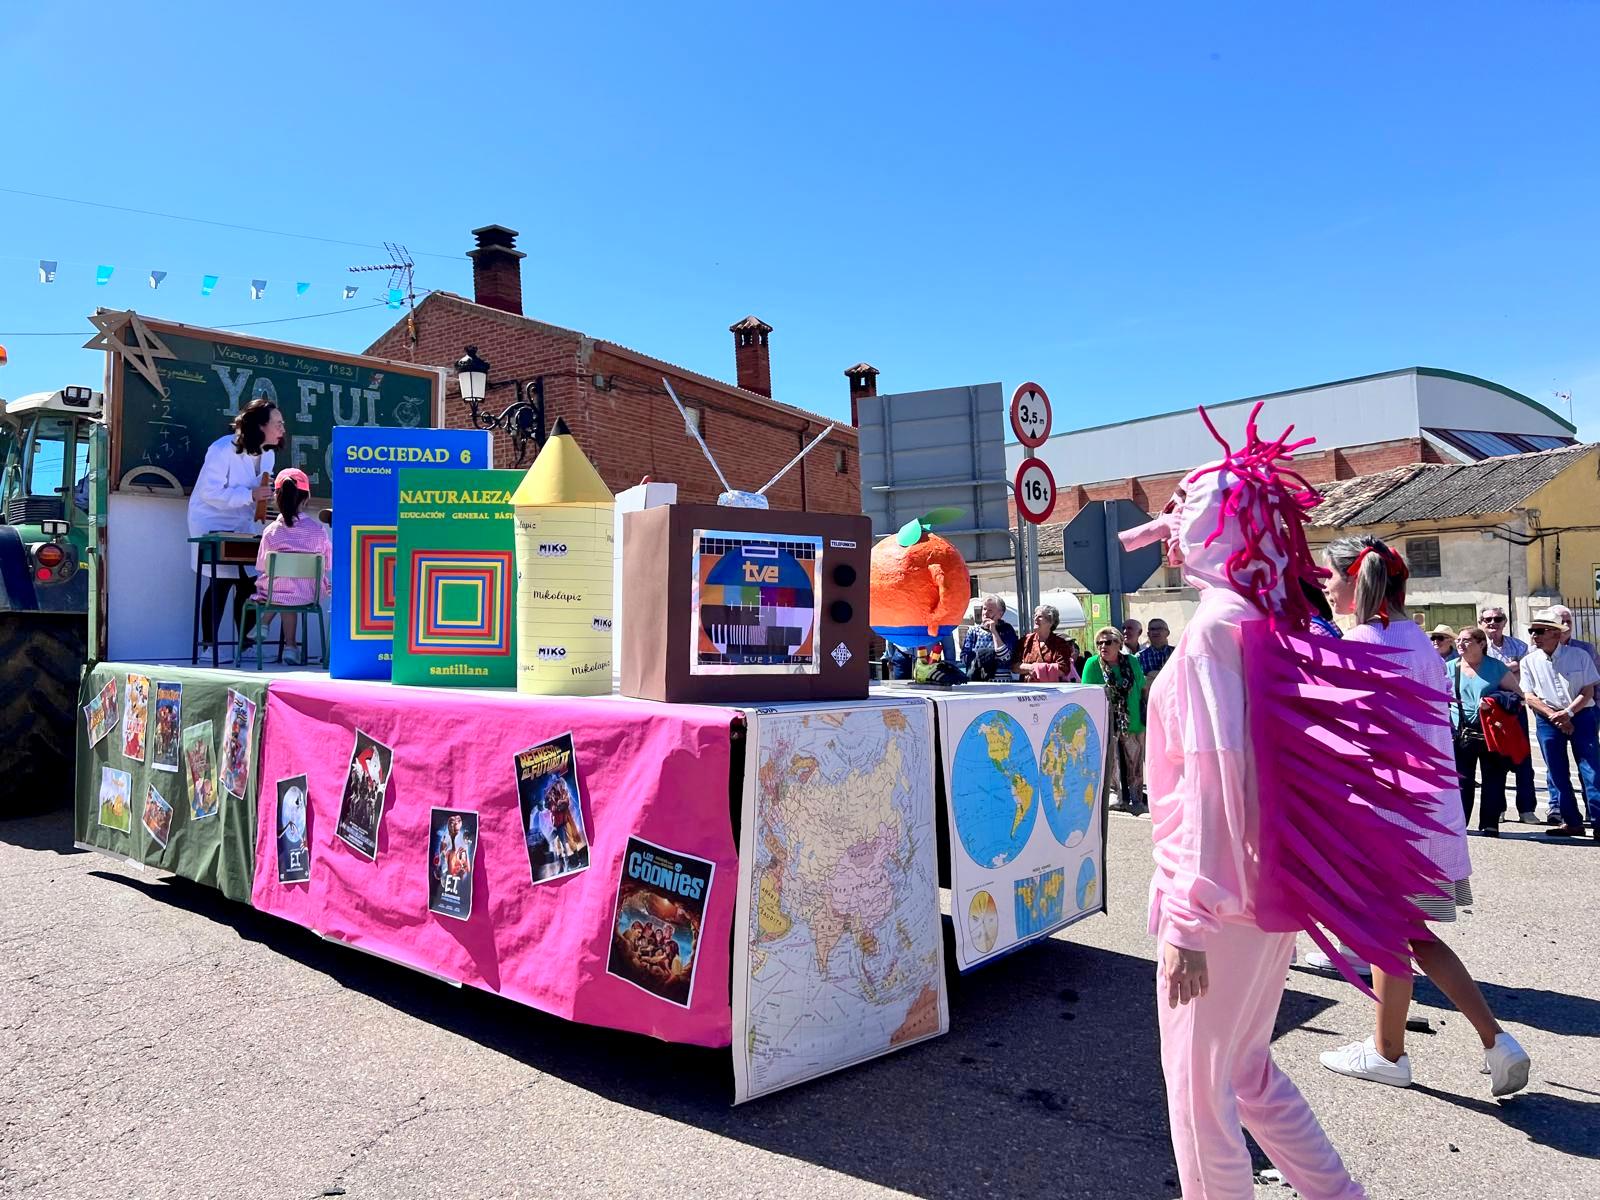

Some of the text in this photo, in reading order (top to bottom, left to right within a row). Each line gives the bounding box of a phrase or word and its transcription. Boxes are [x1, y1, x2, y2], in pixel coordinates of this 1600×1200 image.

[216, 344, 258, 363] Viernes
[264, 354, 275, 365] 10
[279, 358, 290, 368] de
[295, 359, 319, 375] Mayo
[1020, 405, 1038, 424] 3,5
[346, 445, 471, 464] SOCIEDAD 6
[344, 466, 392, 475] EDUCACIÓN
[399, 490, 512, 504] NATURALEZA
[1025, 480, 1048, 501] 16 t
[400, 510, 445, 519] EDUCACIÓN
[451, 512, 490, 520] GENERAL
[539, 543, 567, 553] MIKO
[742, 560, 779, 583] tve
[538, 647, 566, 656] MIKO
[430, 664, 489, 676] santillana
